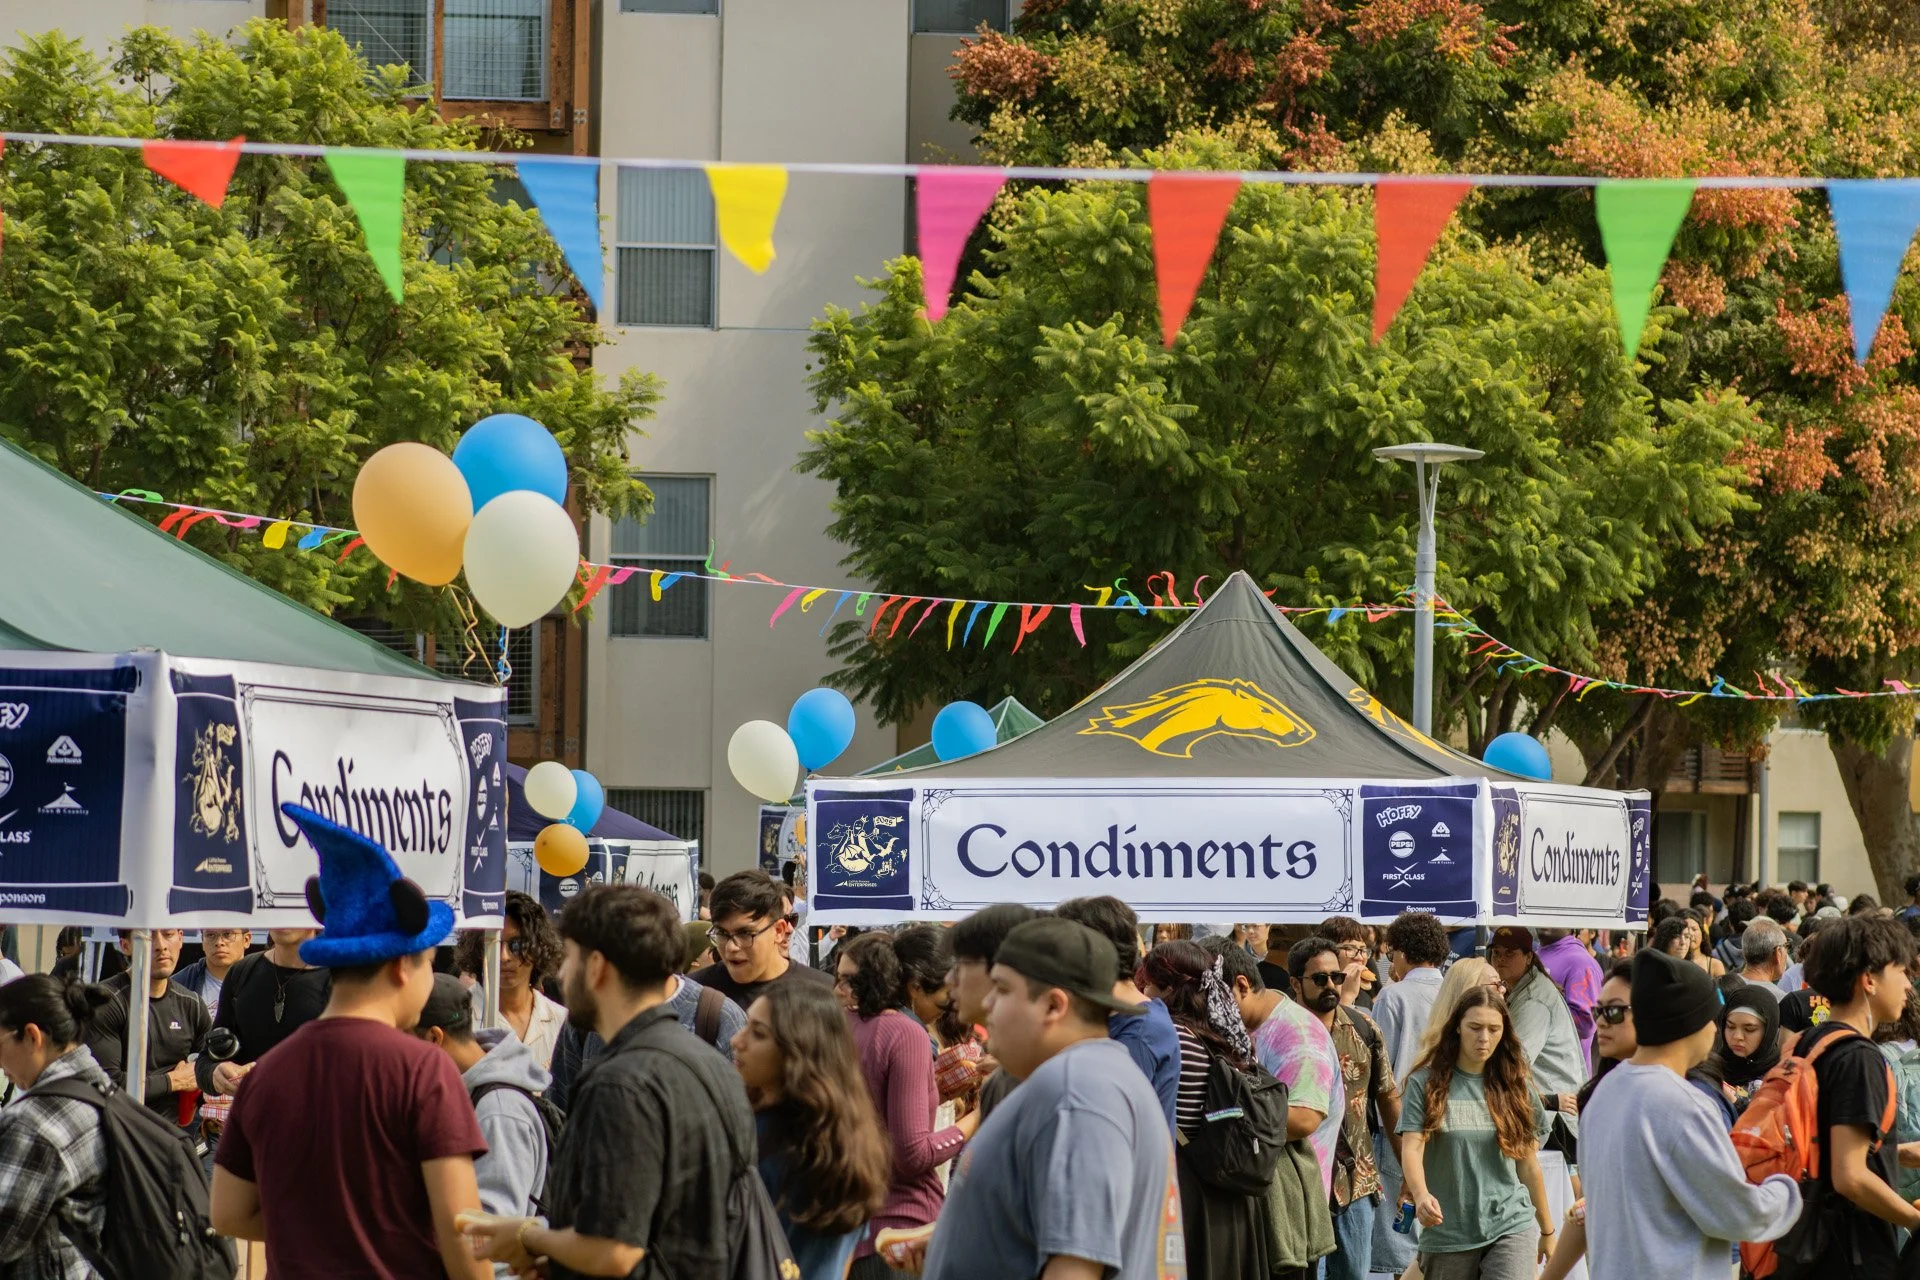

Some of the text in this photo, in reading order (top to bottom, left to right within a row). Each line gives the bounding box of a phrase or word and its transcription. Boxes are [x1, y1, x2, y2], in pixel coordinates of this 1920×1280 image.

[1376, 804, 1422, 828] HOFFY
[0, 831, 31, 843] LASS
[957, 823, 1318, 880] Condiments
[1531, 827, 1620, 887] Condiments
[0, 893, 46, 905] ponsors
[1406, 905, 1436, 913] Sponsors
